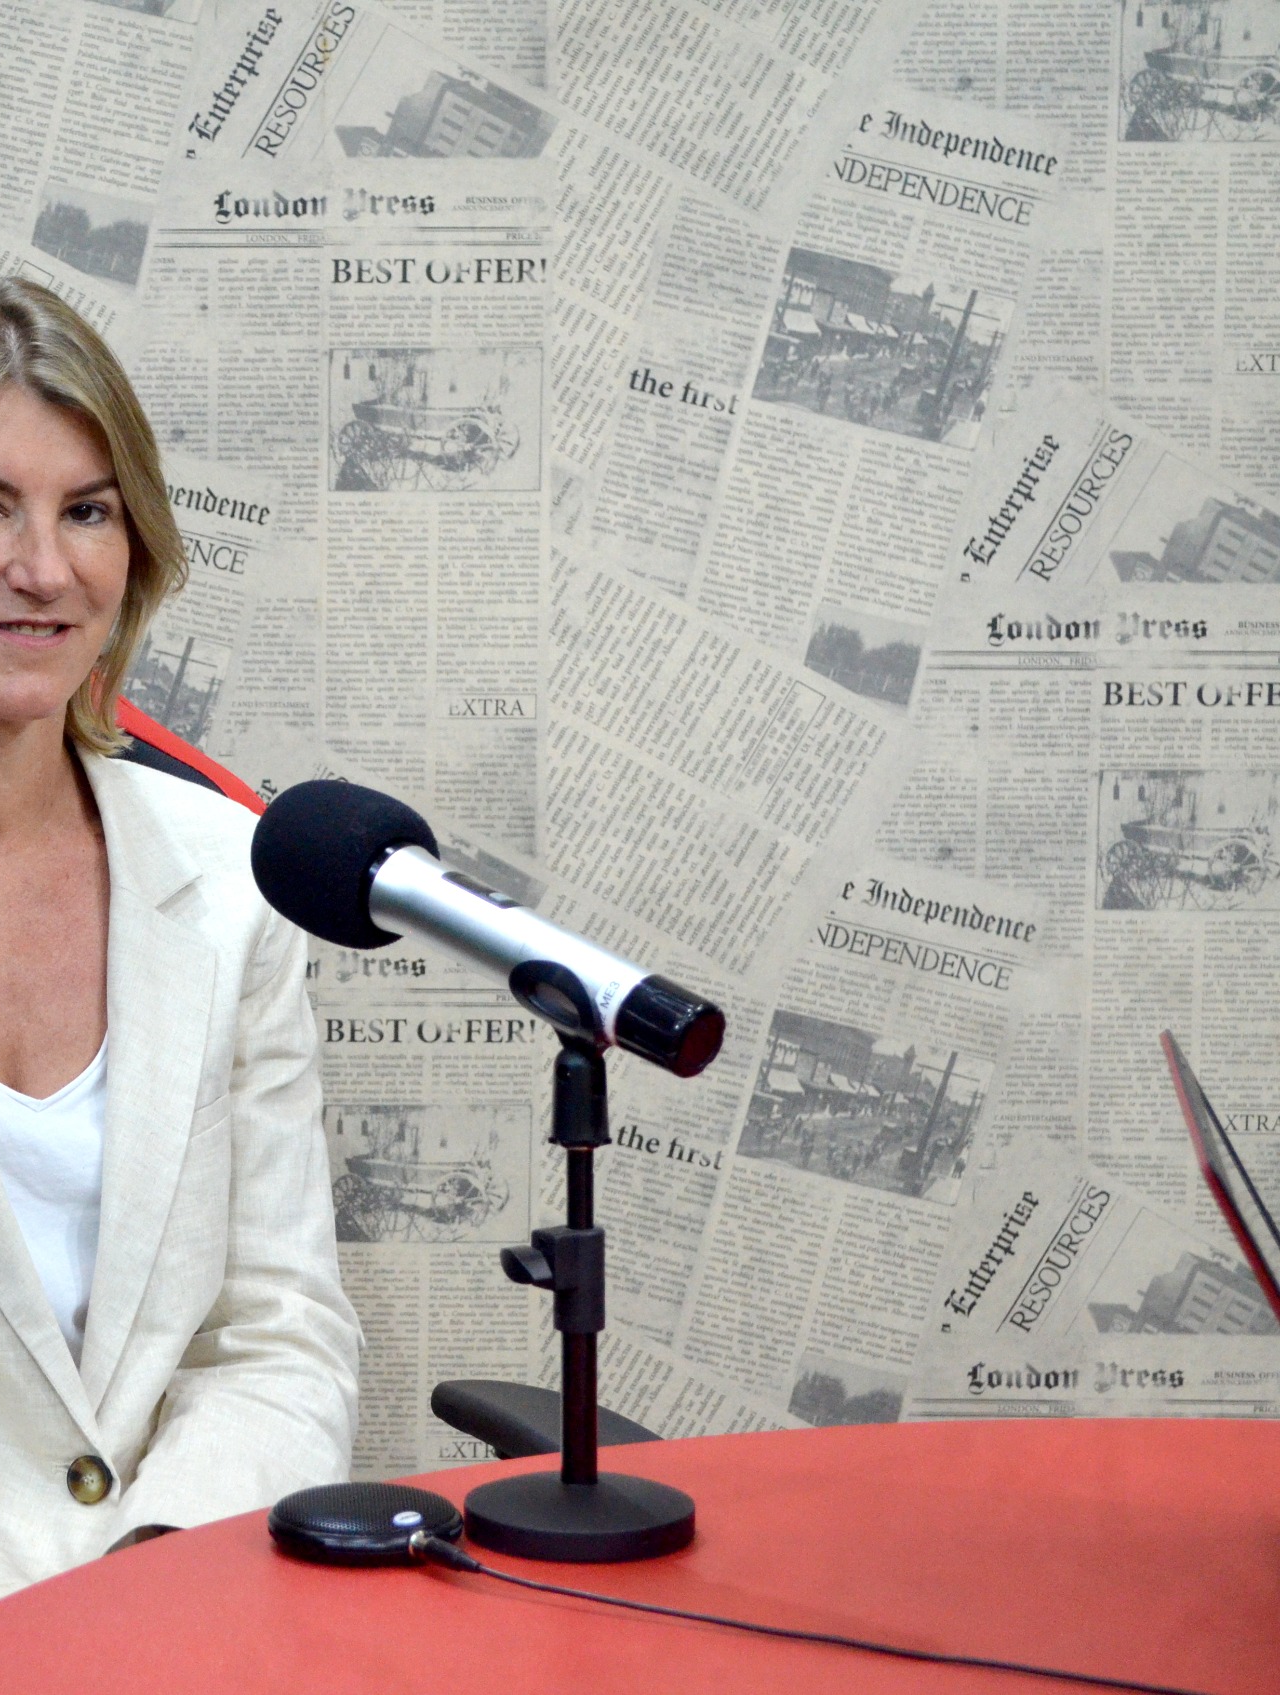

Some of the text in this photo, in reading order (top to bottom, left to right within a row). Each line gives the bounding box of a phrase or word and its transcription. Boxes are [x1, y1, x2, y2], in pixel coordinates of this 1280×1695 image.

[189, 7, 283, 142] Enterprise
[255, 1, 356, 158] RESOURCES
[880, 110, 1058, 176] Independence
[213, 186, 436, 225] London Press
[330, 257, 547, 284] BEST OFFER!
[629, 368, 739, 415] the first
[963, 434, 1060, 565] Enterprise
[1029, 429, 1133, 582] RESOURCES
[986, 612, 1208, 647] London Press
[1102, 681, 1187, 707] BEST
[862, 878, 1037, 943] Independence
[335, 950, 427, 983] Press
[324, 1018, 537, 1044] BEST OFFER!
[617, 1125, 724, 1170] the first
[944, 1191, 1039, 1317] Enterprise
[1010, 1186, 1110, 1333] RESOURCES
[967, 1361, 1185, 1395] London Press
